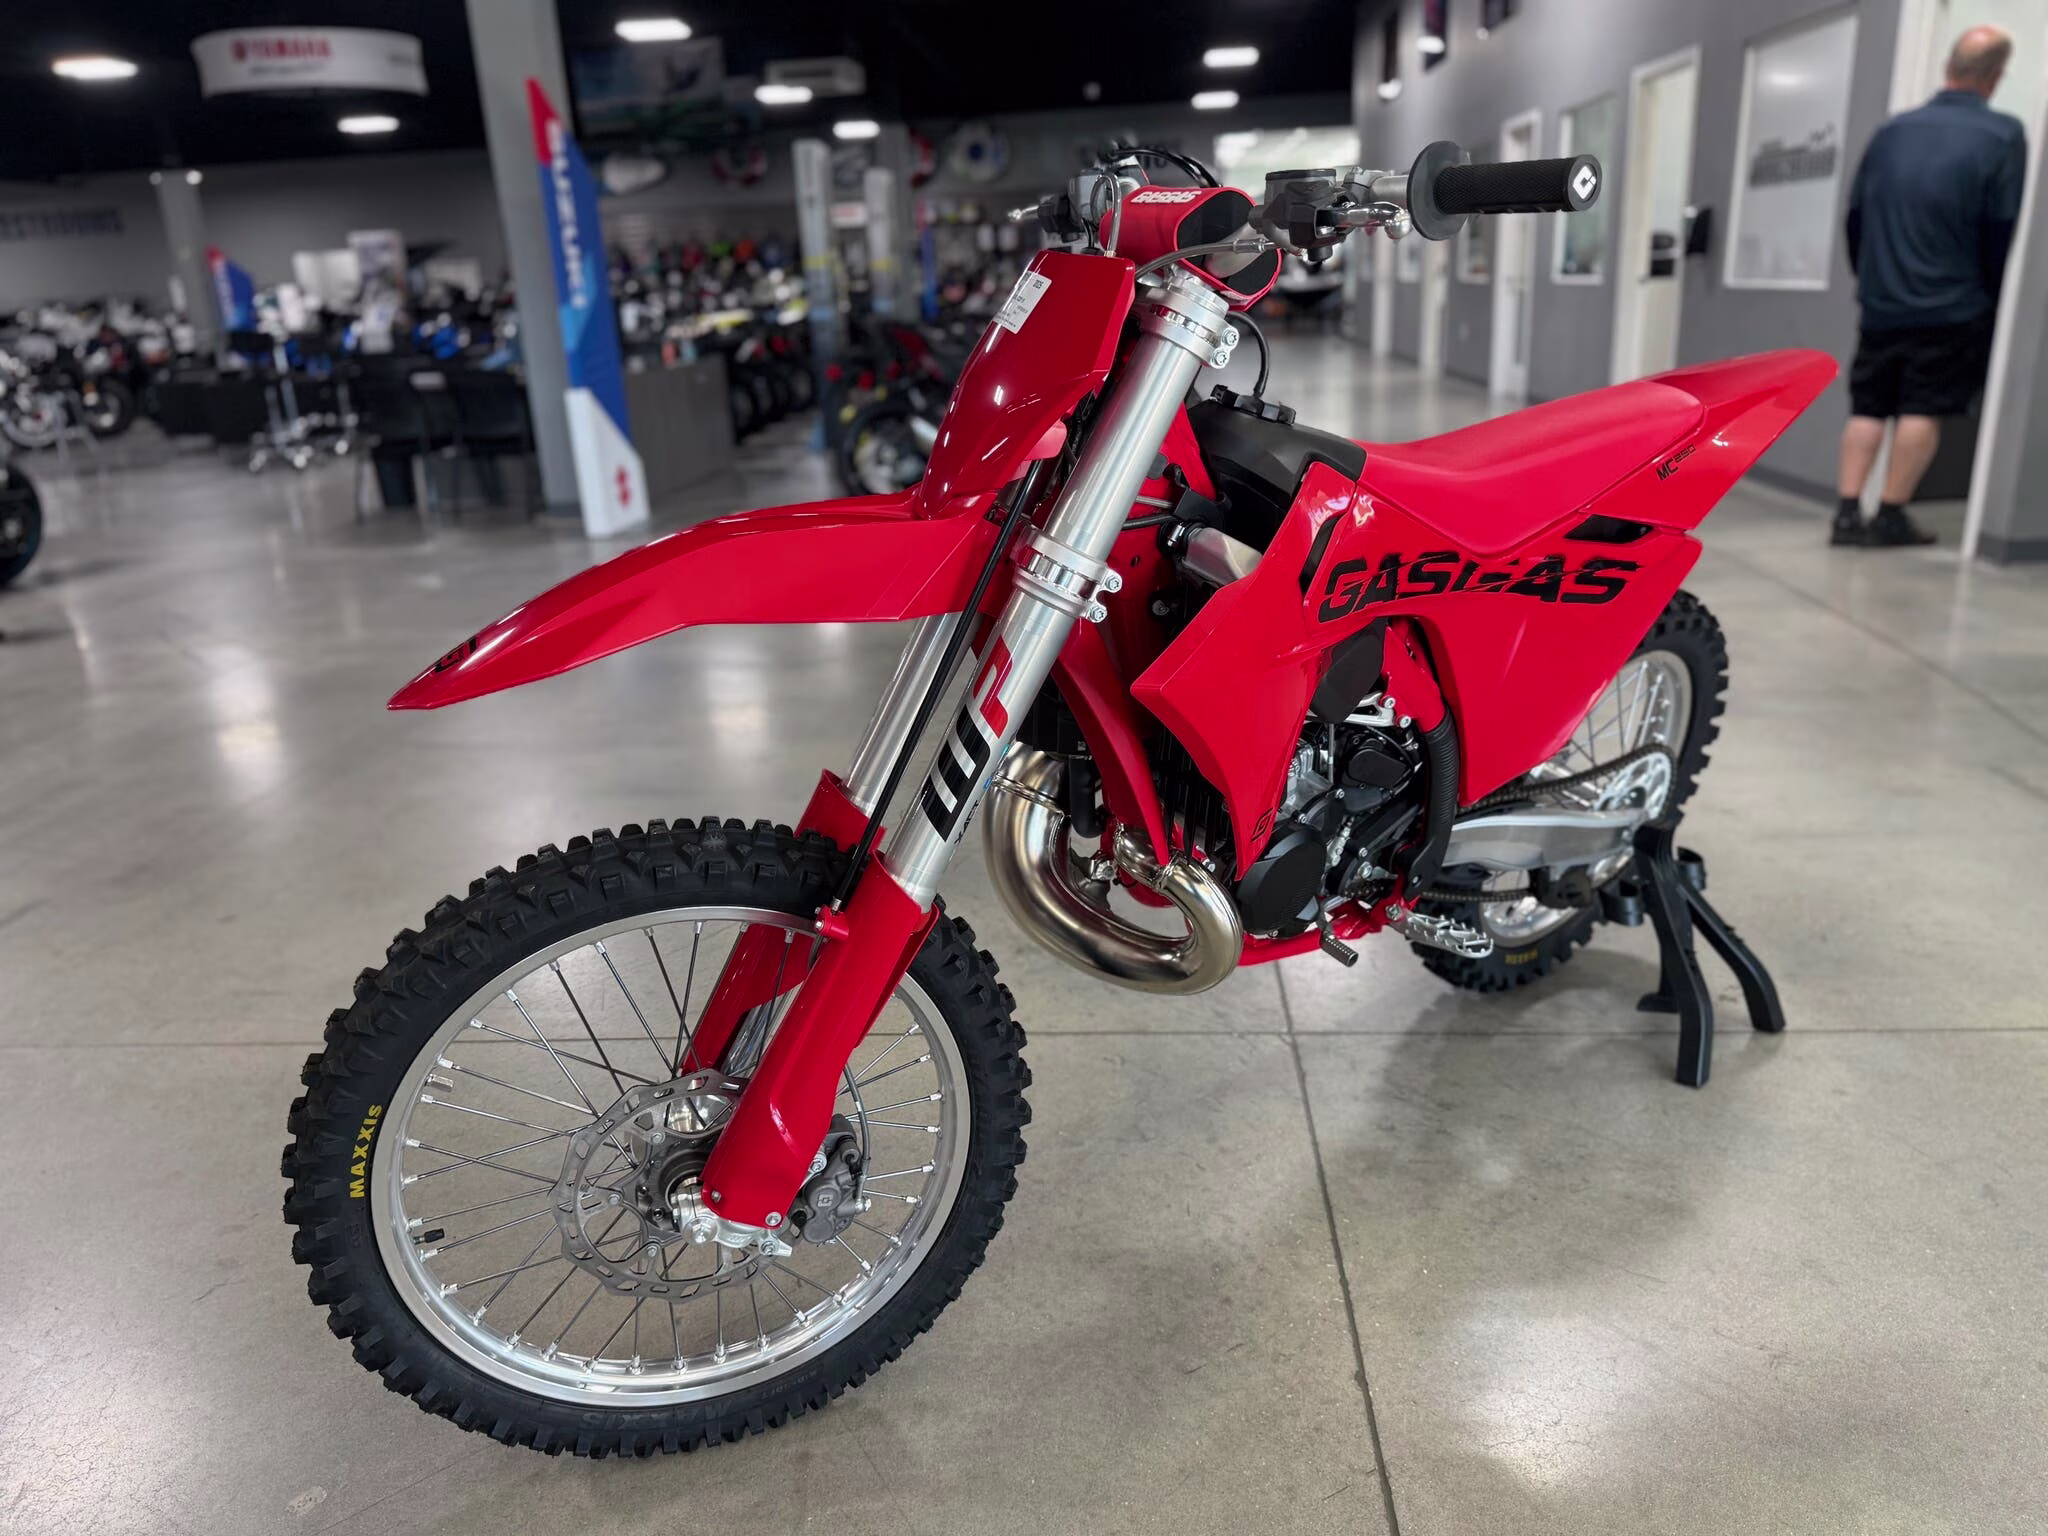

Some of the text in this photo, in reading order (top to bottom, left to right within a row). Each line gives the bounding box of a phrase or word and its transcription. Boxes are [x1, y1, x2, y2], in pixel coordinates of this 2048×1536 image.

[545, 118, 589, 309] SUZUKI
[1131, 190, 1202, 205] GASGAS
[1317, 551, 1640, 624] GASGAS
[349, 1104, 384, 1199] MAXXIS
